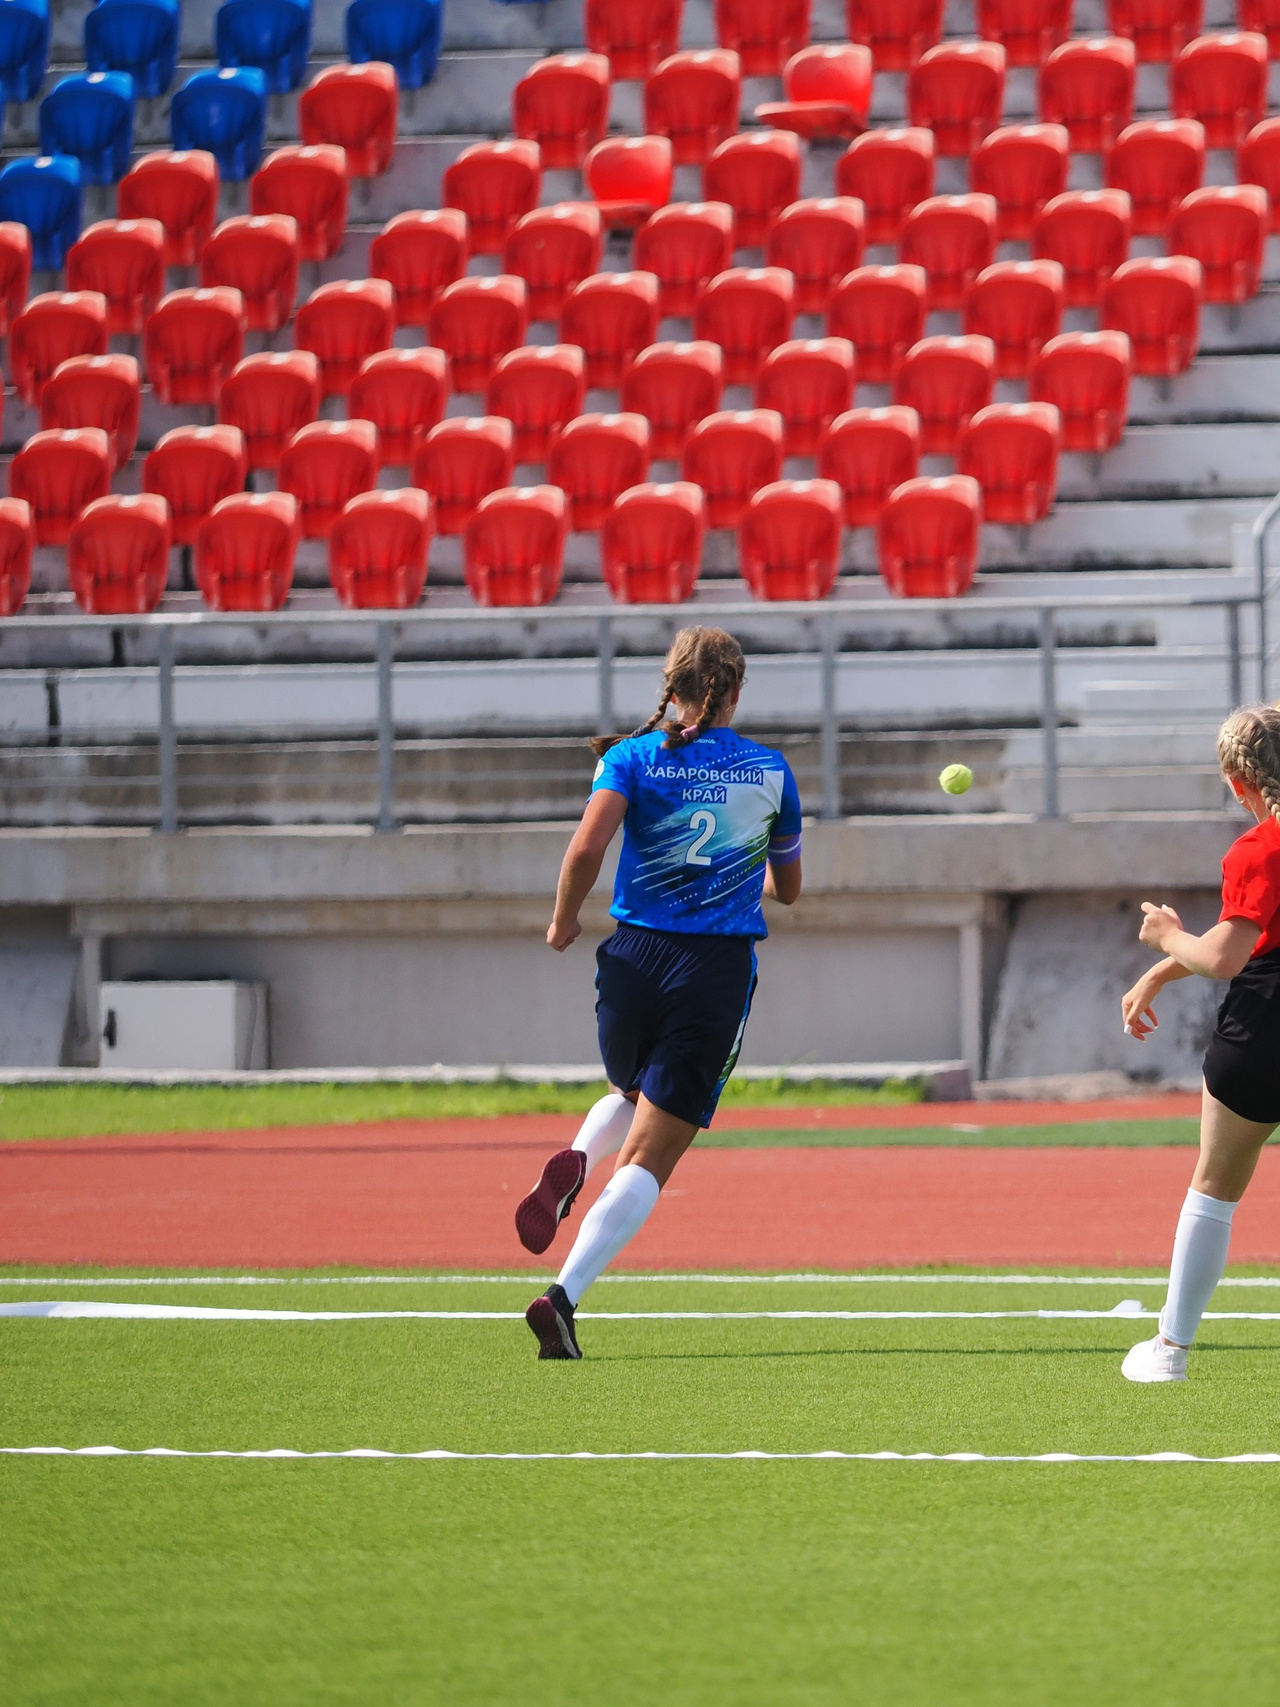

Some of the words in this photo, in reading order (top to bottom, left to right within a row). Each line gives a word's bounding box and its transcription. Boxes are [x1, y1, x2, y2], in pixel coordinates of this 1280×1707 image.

[645, 765, 763, 784] ХАБАРОВСКИЙ
[682, 787, 725, 803] КРАЙ
[686, 810, 716, 865] 2
